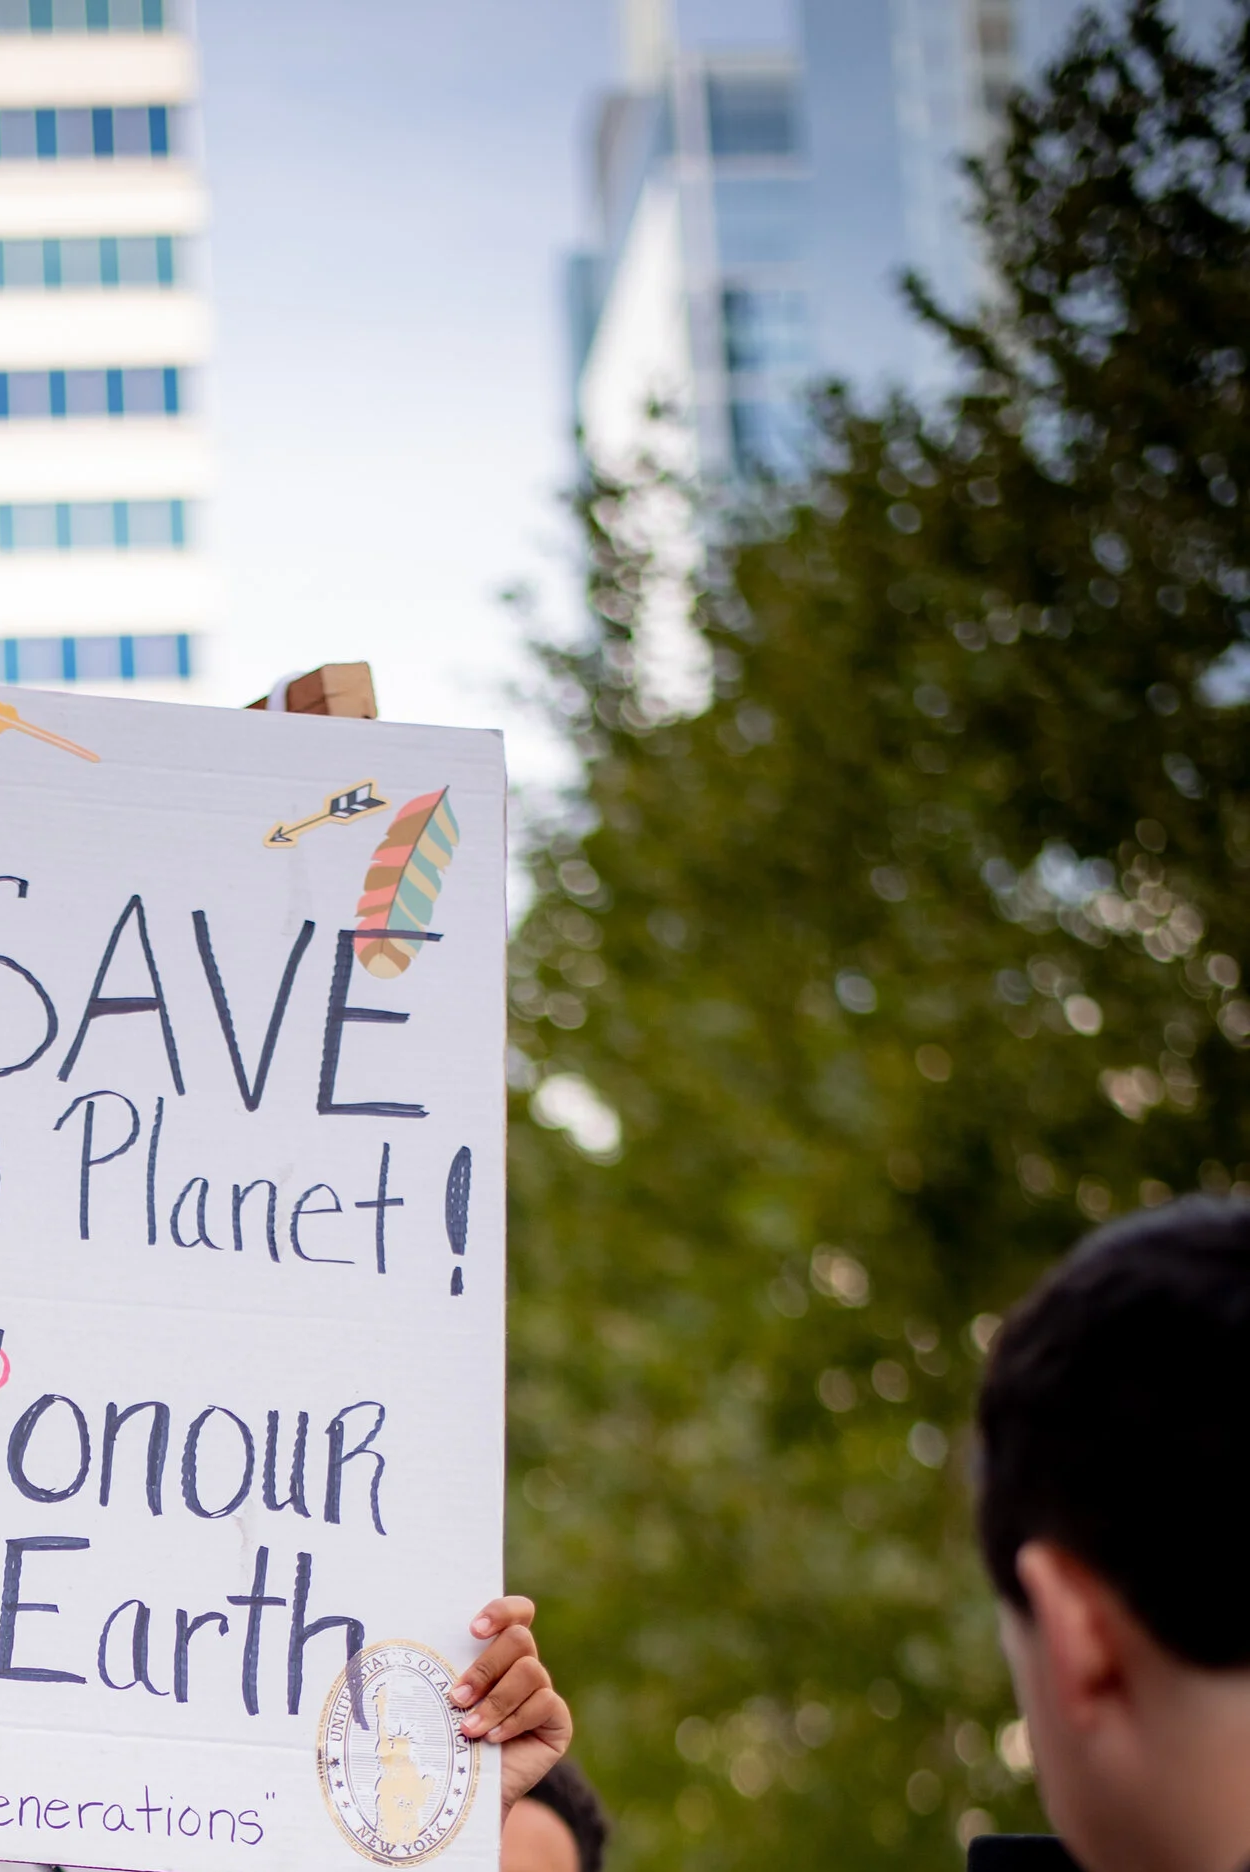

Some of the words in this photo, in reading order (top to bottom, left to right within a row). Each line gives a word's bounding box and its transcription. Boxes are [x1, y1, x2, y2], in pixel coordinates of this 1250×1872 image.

[330, 1676, 358, 1742] UNITE
[357, 1652, 412, 1682] STATS
[418, 1659, 440, 1678] OF
[356, 1824, 398, 1856] NEW
[401, 1824, 448, 1857] YORK
